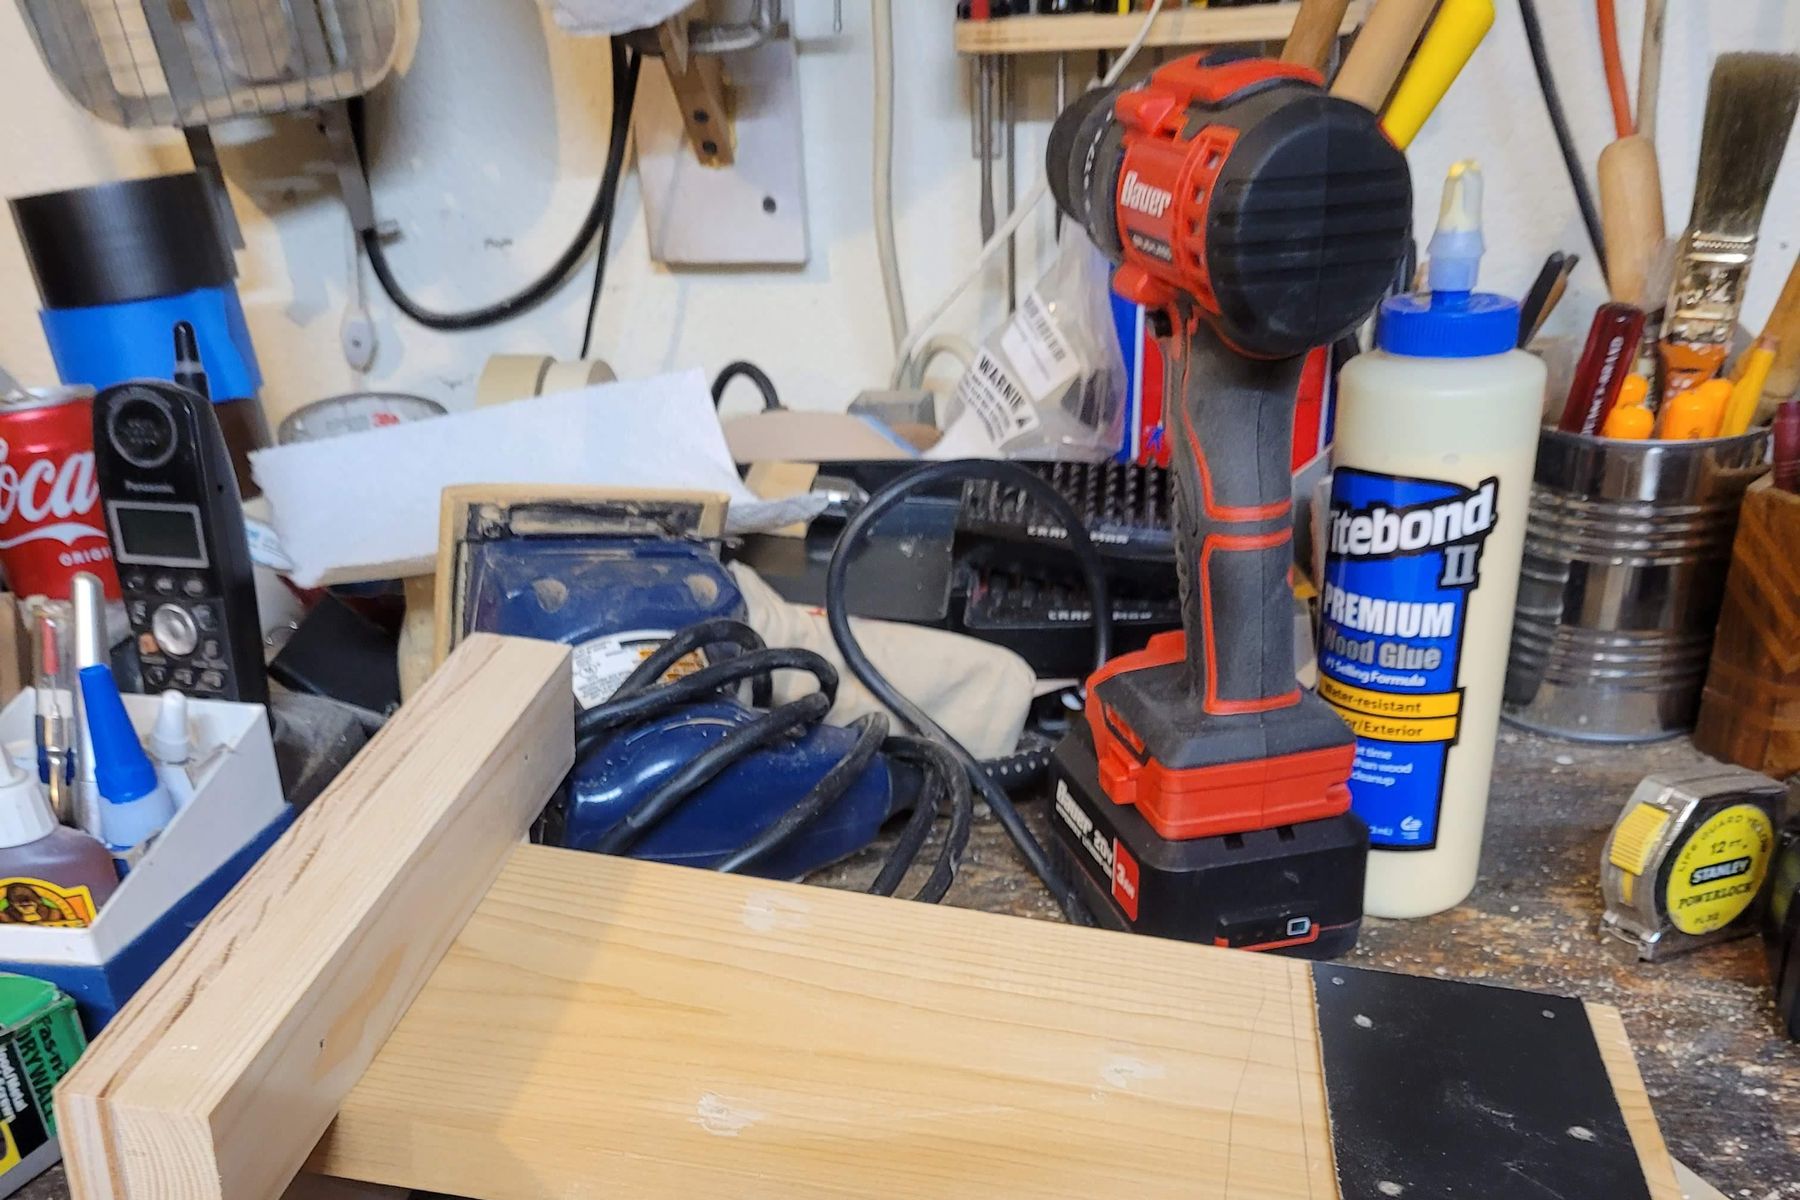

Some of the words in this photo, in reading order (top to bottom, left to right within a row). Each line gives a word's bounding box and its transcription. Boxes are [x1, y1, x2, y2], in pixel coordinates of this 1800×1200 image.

[1120, 169, 1172, 218] Bauer
[0, 437, 100, 524] oca
[1331, 483, 1495, 556] itebond
[58, 546, 112, 567] ORIGI
[1324, 581, 1455, 638] PREMIUM
[1322, 622, 1375, 665] Wood
[1378, 641, 1442, 669] Glue
[1678, 881, 1754, 909] POWERLOCK
[1691, 859, 1750, 884] STANLEY
